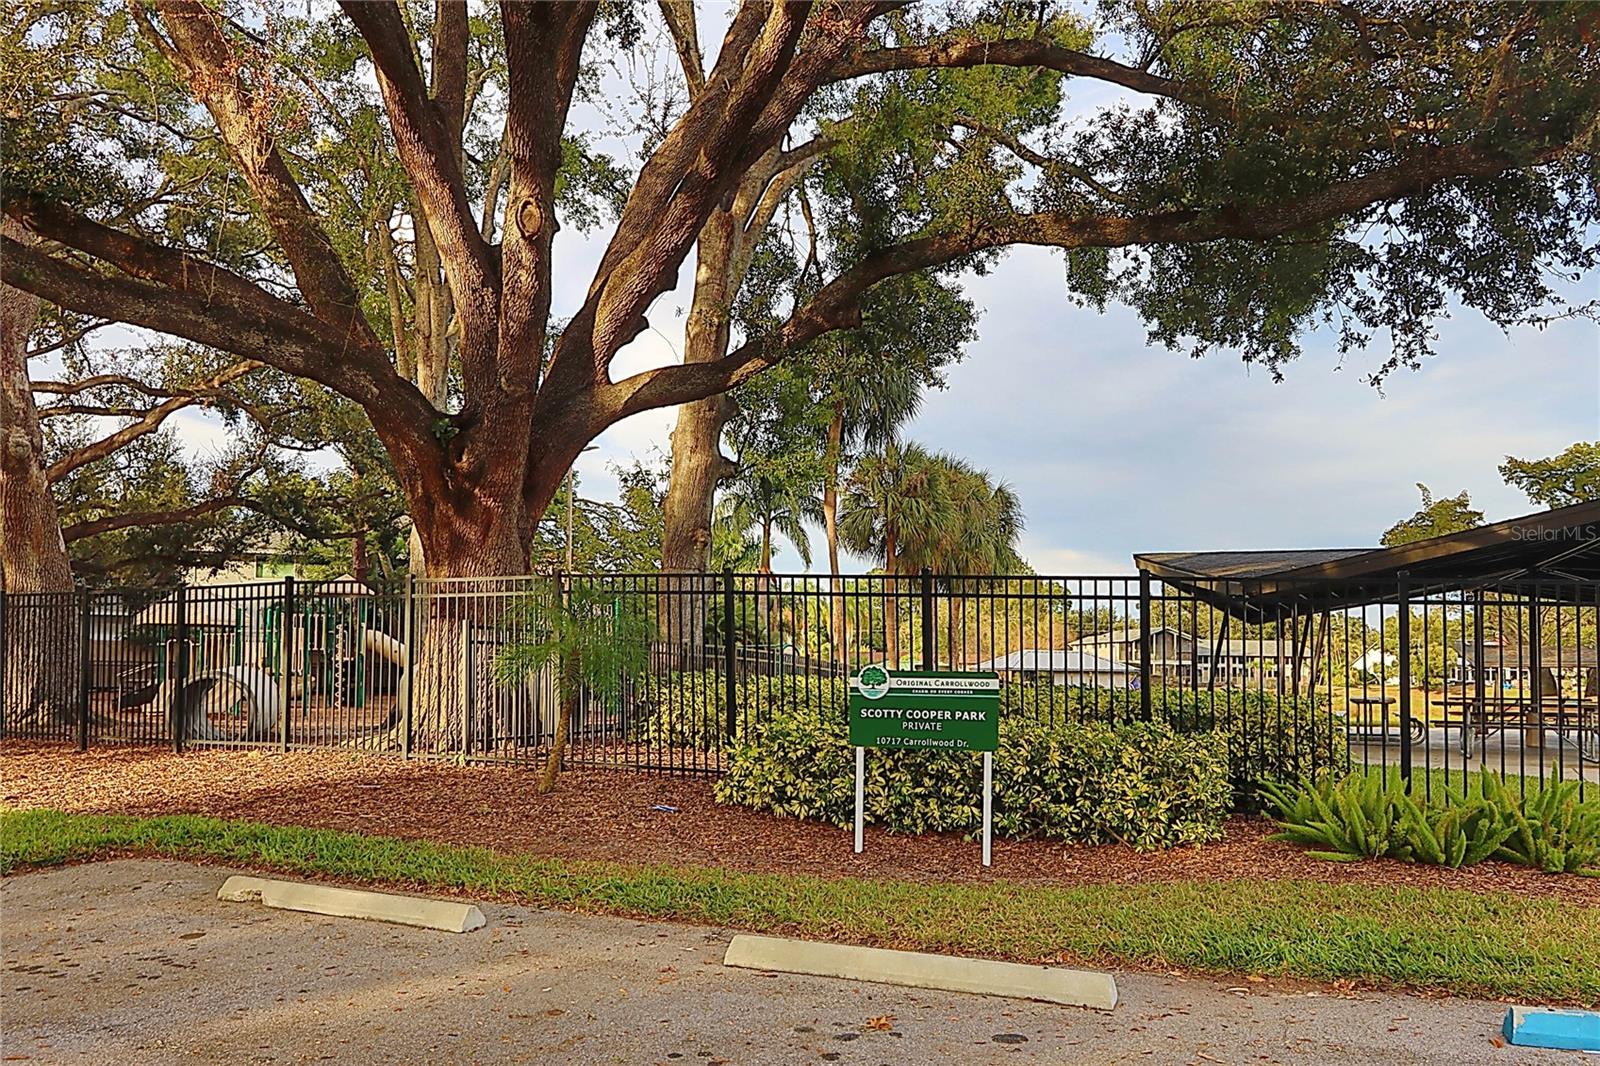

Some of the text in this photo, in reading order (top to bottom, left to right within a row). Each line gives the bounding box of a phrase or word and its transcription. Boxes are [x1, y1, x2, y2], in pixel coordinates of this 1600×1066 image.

[860, 709, 986, 721] SCOTTY COOPER PARK
[902, 722, 942, 731] PRIVATE
[876, 737, 969, 748] 10717 Carrollwood Dr.
